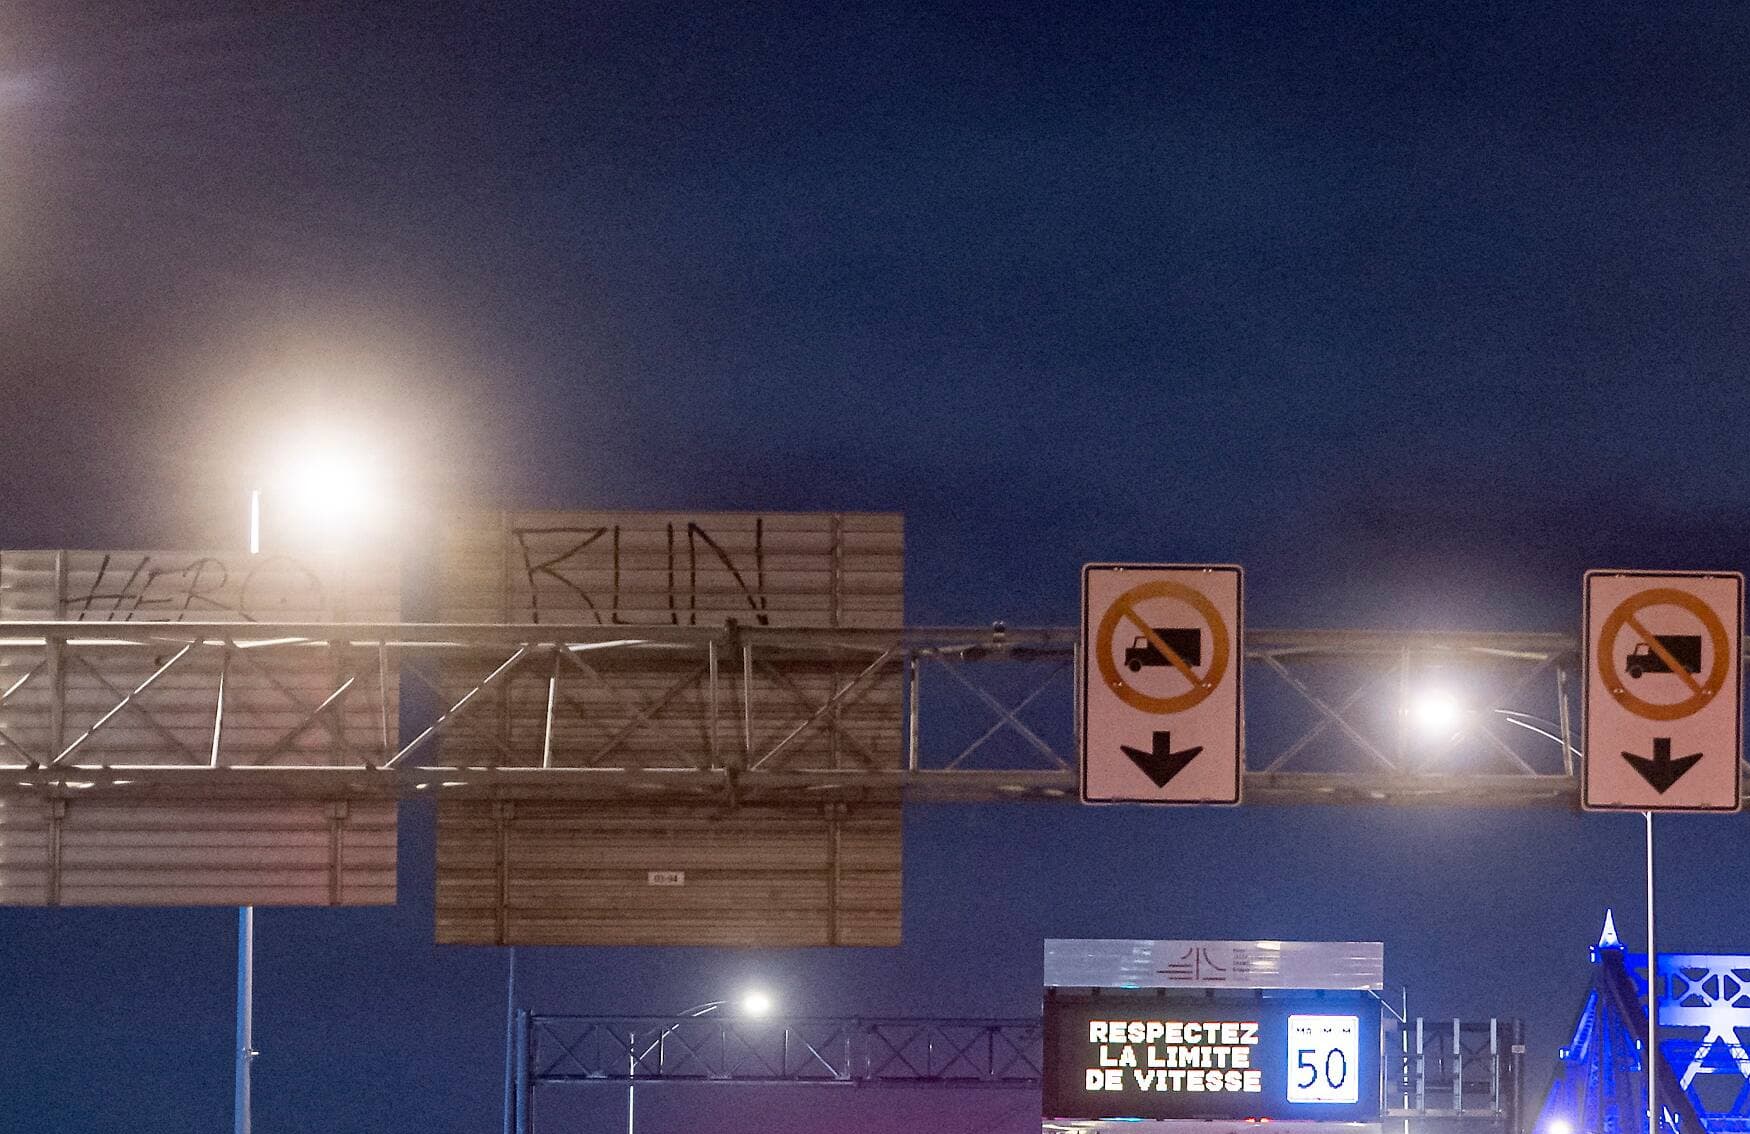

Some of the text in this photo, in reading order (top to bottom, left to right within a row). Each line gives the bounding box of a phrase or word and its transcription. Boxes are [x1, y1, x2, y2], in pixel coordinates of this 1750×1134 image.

[512, 518, 768, 625] RUN
[1088, 1020, 1259, 1045] RESPECTEZ
[1099, 1044, 1251, 1069] LA LIMITE
[1297, 1047, 1347, 1090] 50
[1085, 1068, 1263, 1093] DE VITESSE
